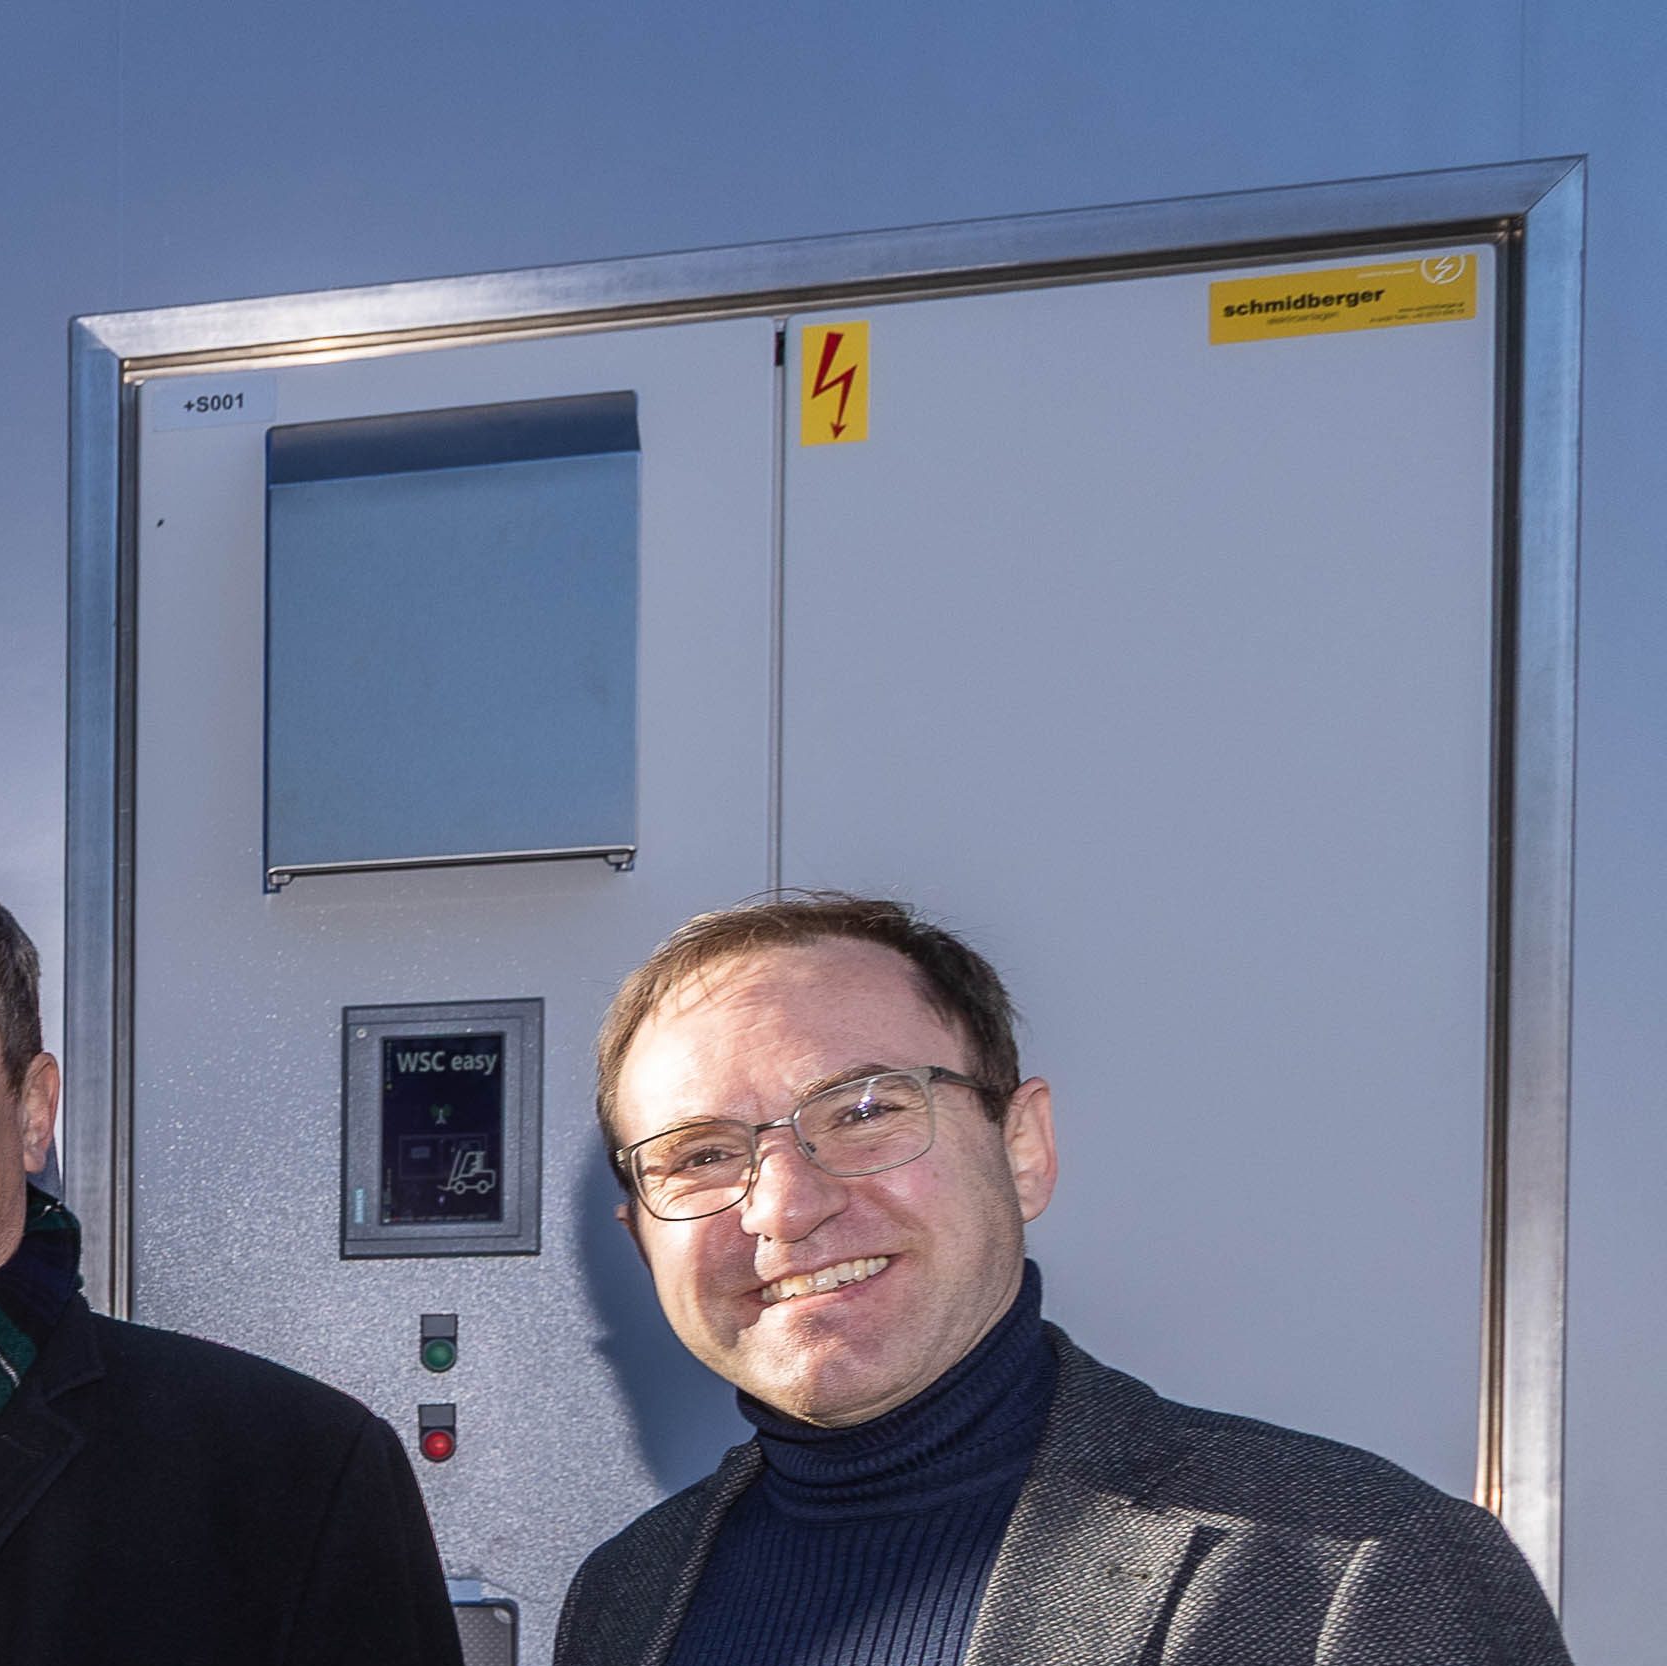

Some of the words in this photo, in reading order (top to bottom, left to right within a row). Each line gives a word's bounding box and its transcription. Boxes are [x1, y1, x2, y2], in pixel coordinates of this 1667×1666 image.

[1223, 288, 1385, 317] schmidberger
[184, 393, 244, 413] +S001
[397, 1051, 445, 1072] WSC
[451, 1053, 497, 1075] easy
